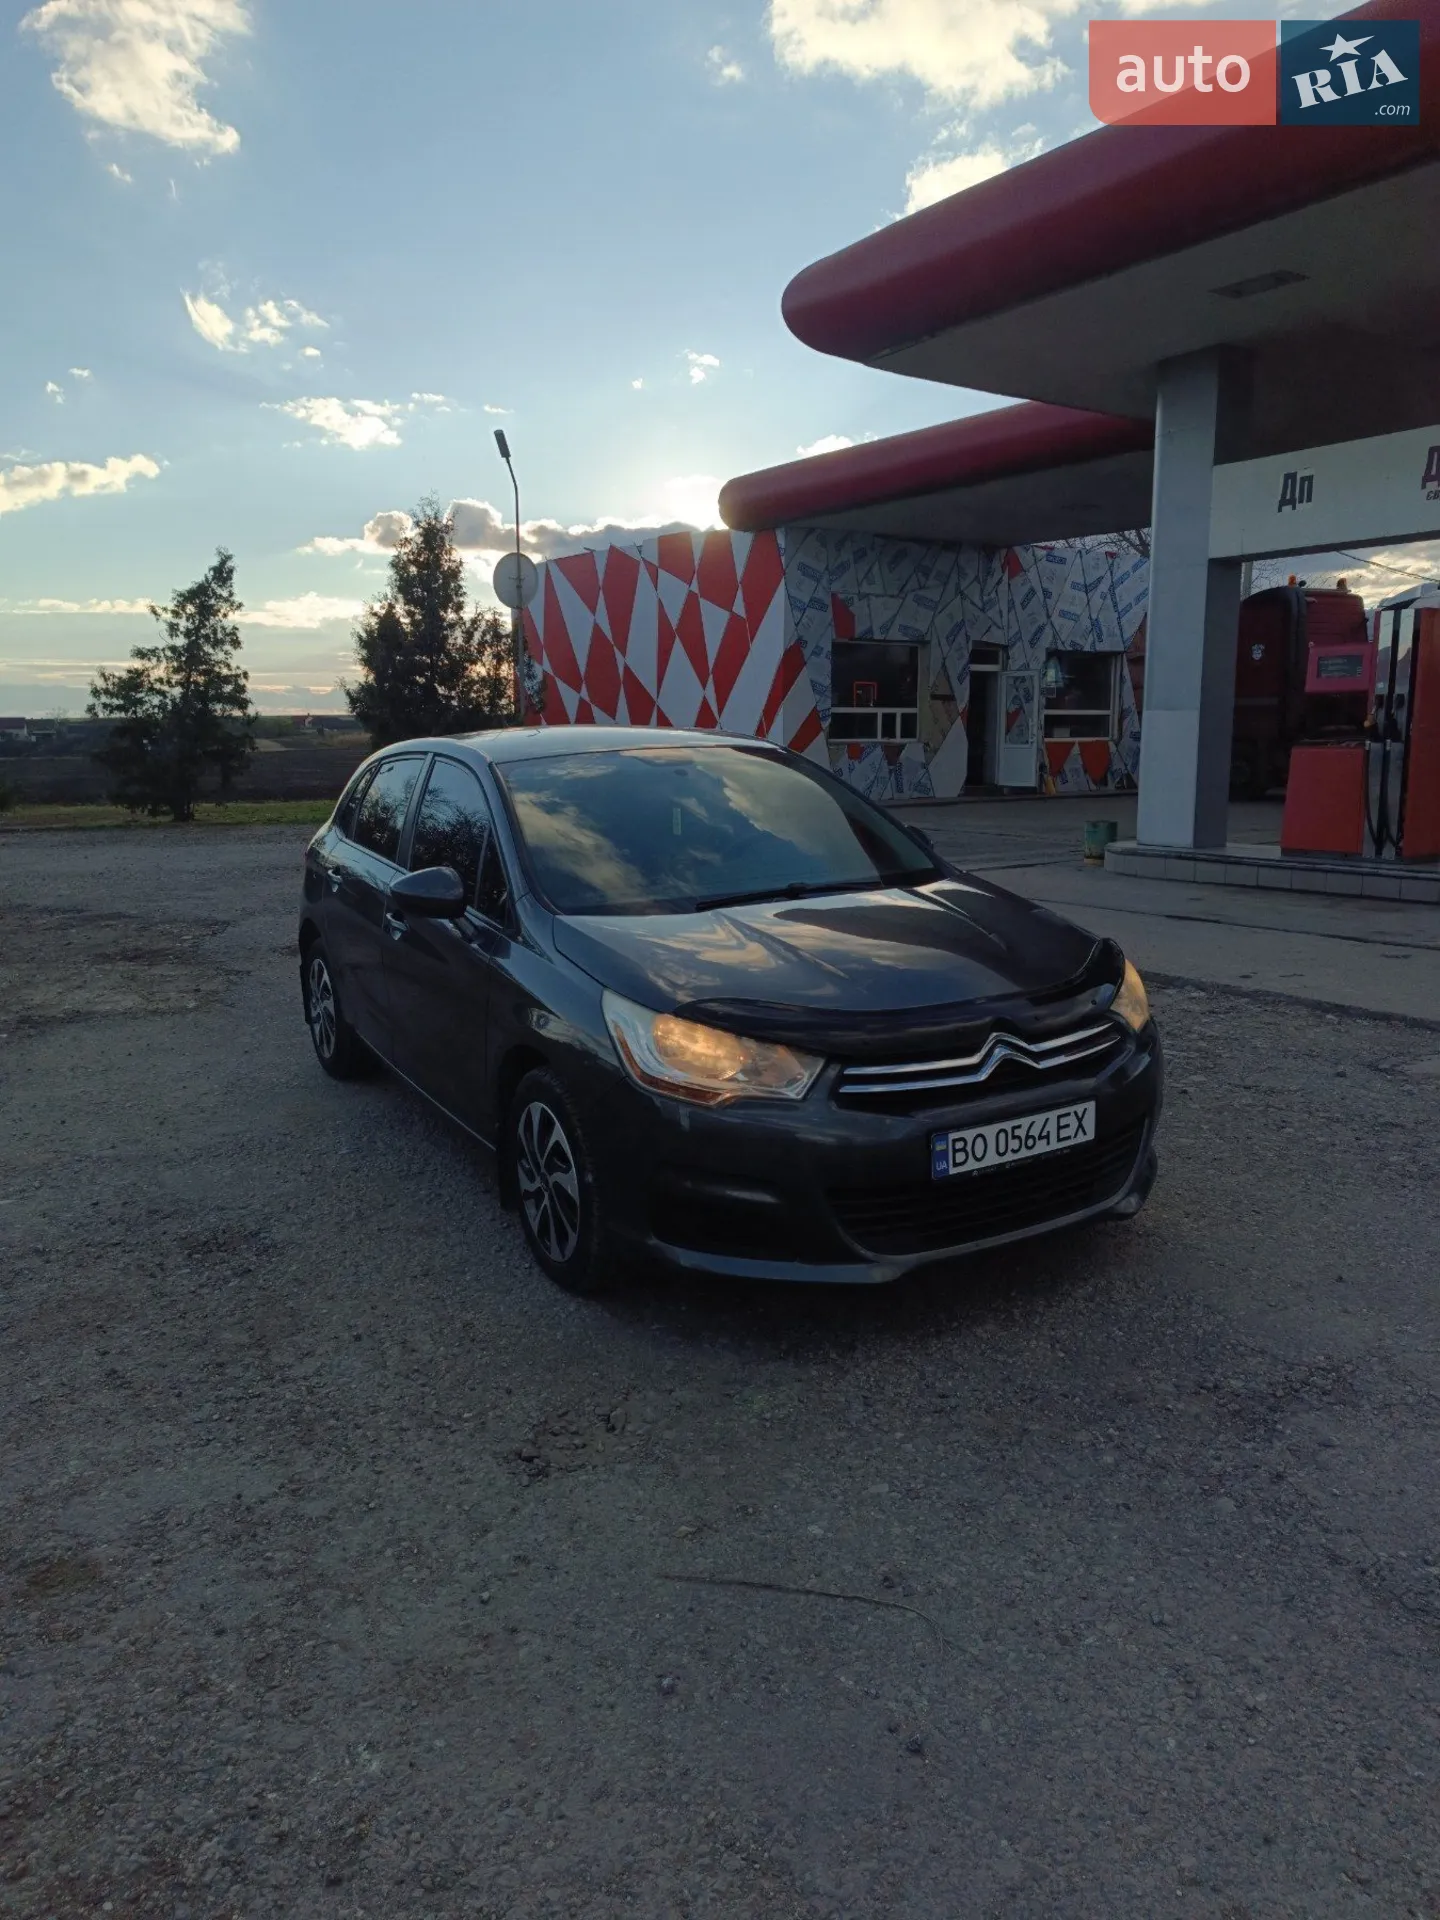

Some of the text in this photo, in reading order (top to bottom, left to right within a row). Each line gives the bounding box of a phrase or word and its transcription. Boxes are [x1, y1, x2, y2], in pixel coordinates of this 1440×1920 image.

[951, 1107, 1088, 1168] BO 0564 EX
[936, 1160, 948, 1171] UA
